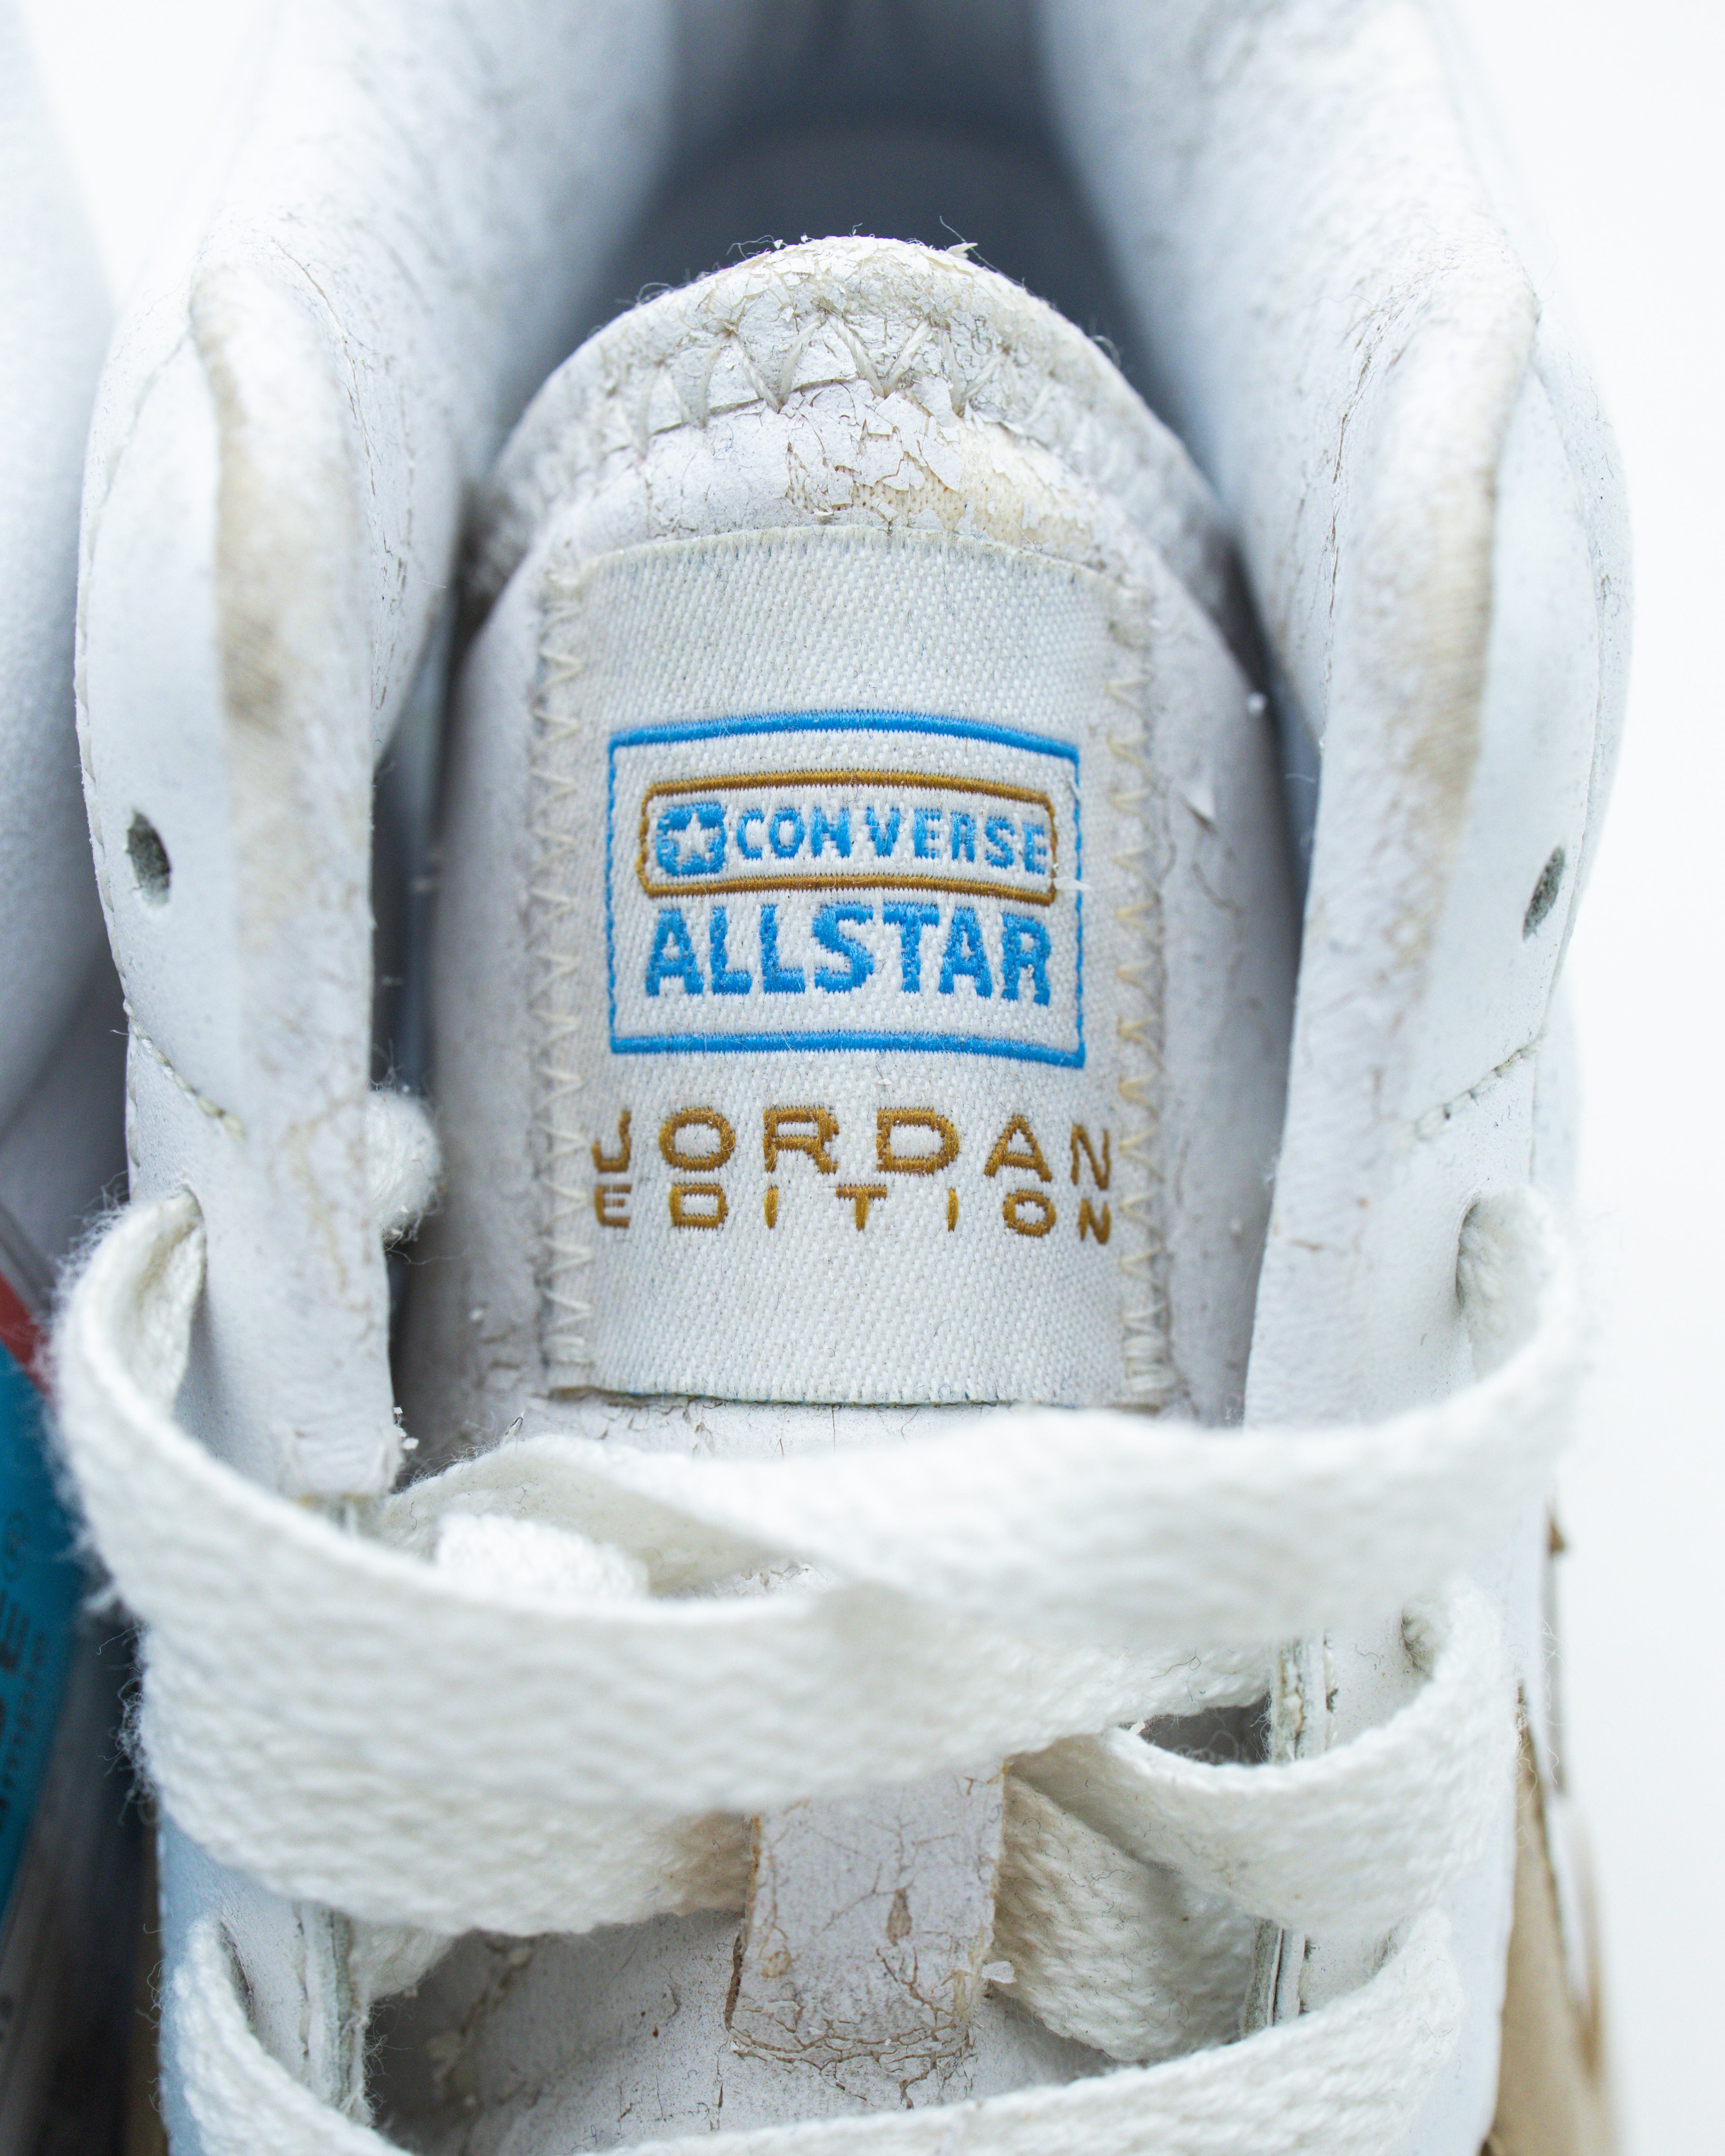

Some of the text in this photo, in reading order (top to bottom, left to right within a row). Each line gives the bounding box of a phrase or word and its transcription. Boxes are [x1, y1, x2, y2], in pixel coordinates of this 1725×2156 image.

[735, 807, 1048, 875] CONVERSE
[592, 1107, 1110, 1189] JORDAN
[594, 1183, 1110, 1243] EDITION
